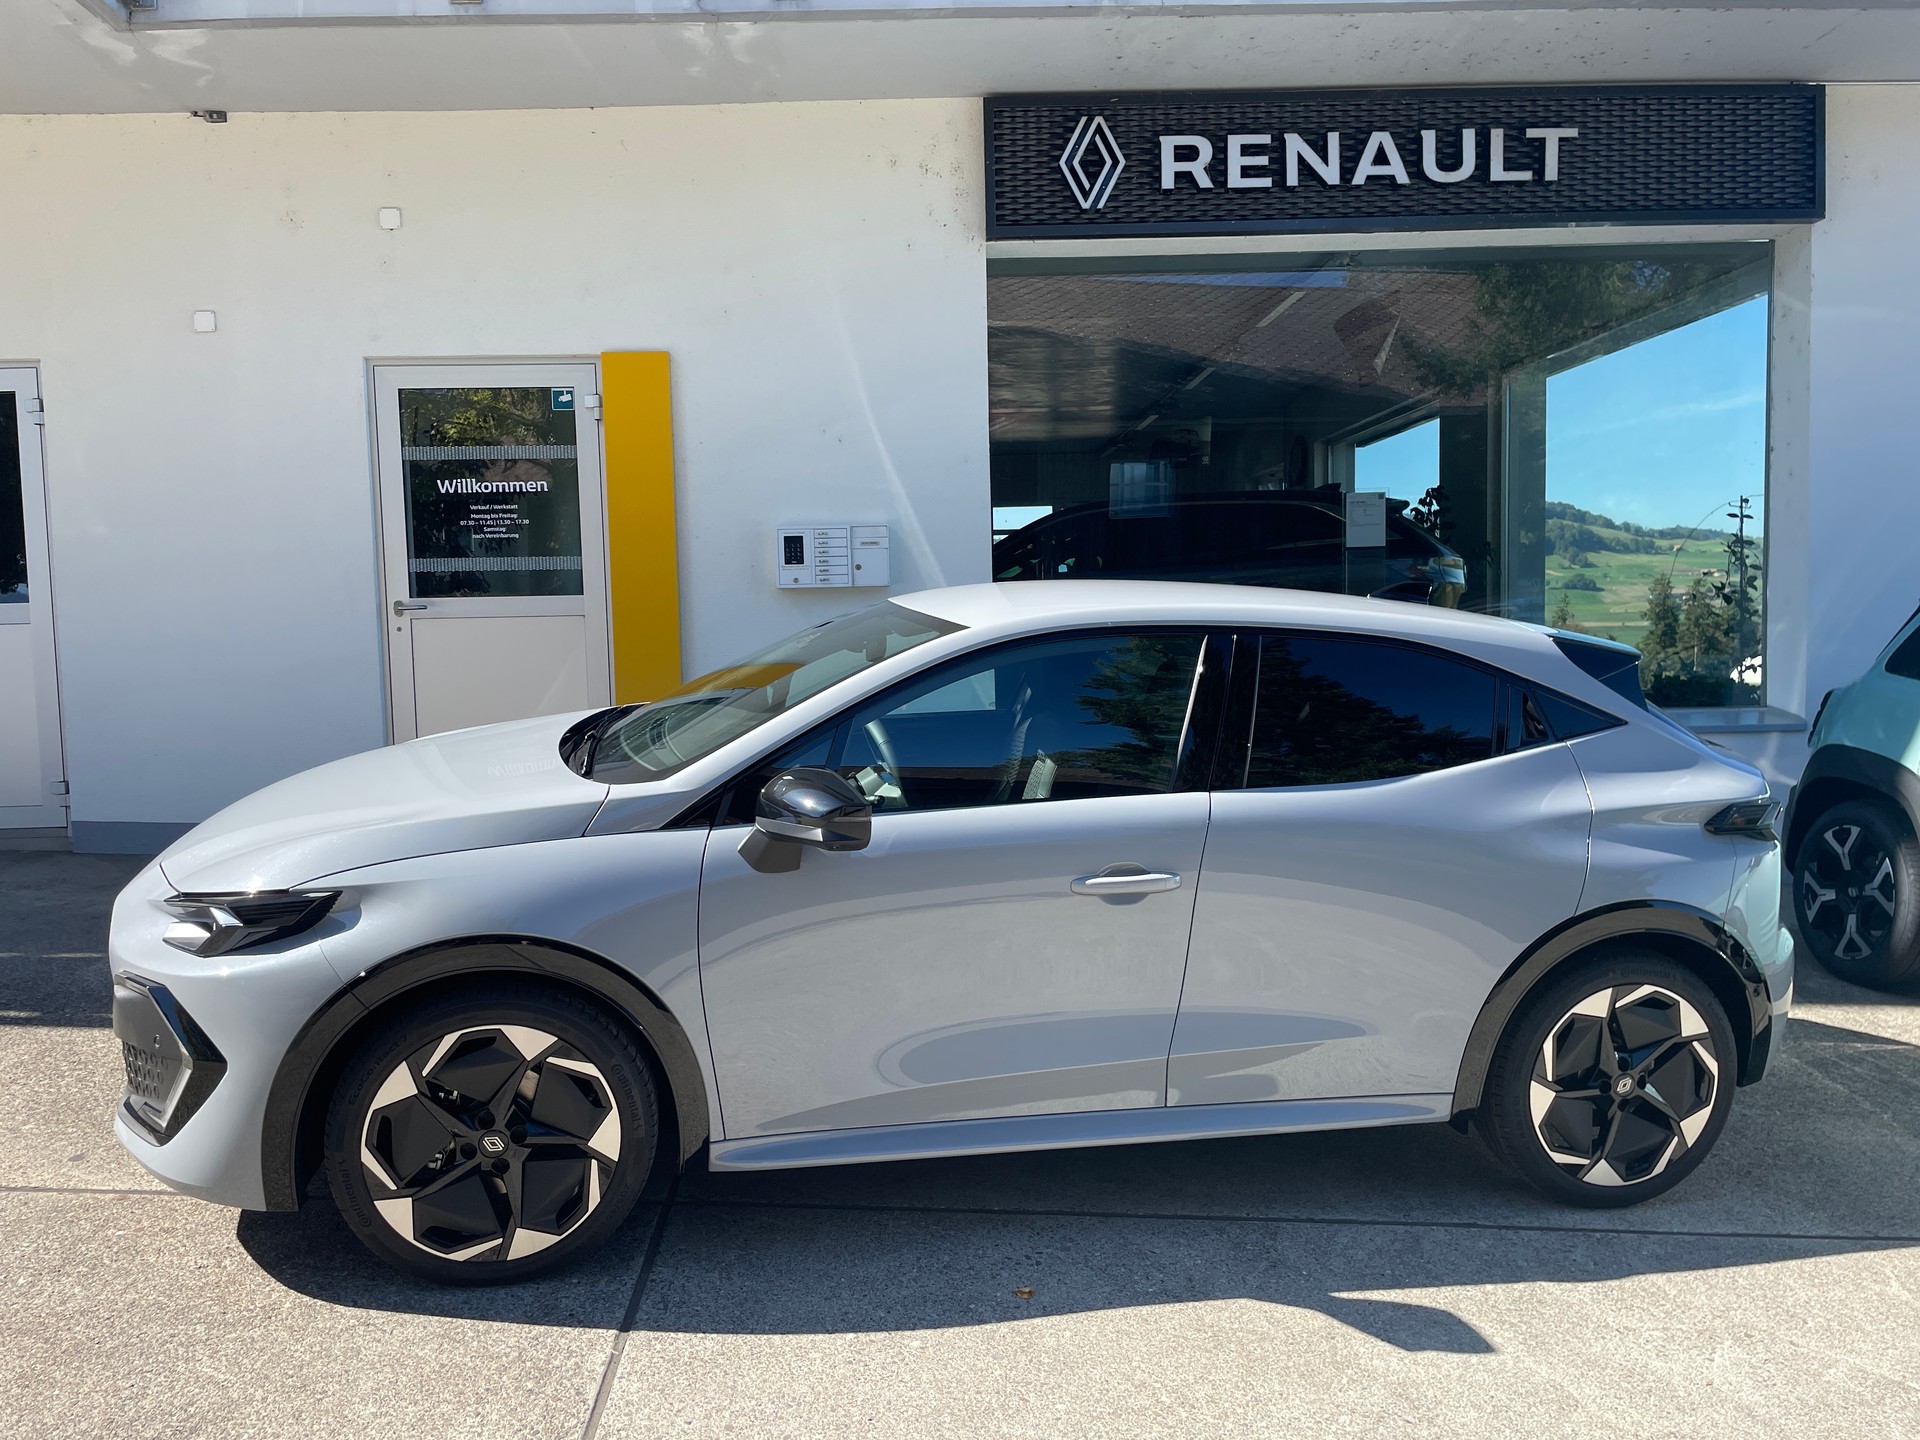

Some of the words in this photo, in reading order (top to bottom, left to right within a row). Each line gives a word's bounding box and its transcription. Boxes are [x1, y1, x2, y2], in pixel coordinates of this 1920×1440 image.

[1159, 128, 1579, 190] RENAULT
[436, 478, 549, 494] Willkommen
[1620, 966, 1671, 979] Continental
[348, 1041, 400, 1105] EcoContact
[611, 1064, 642, 1122] Continental
[338, 1168, 372, 1228] Continental
